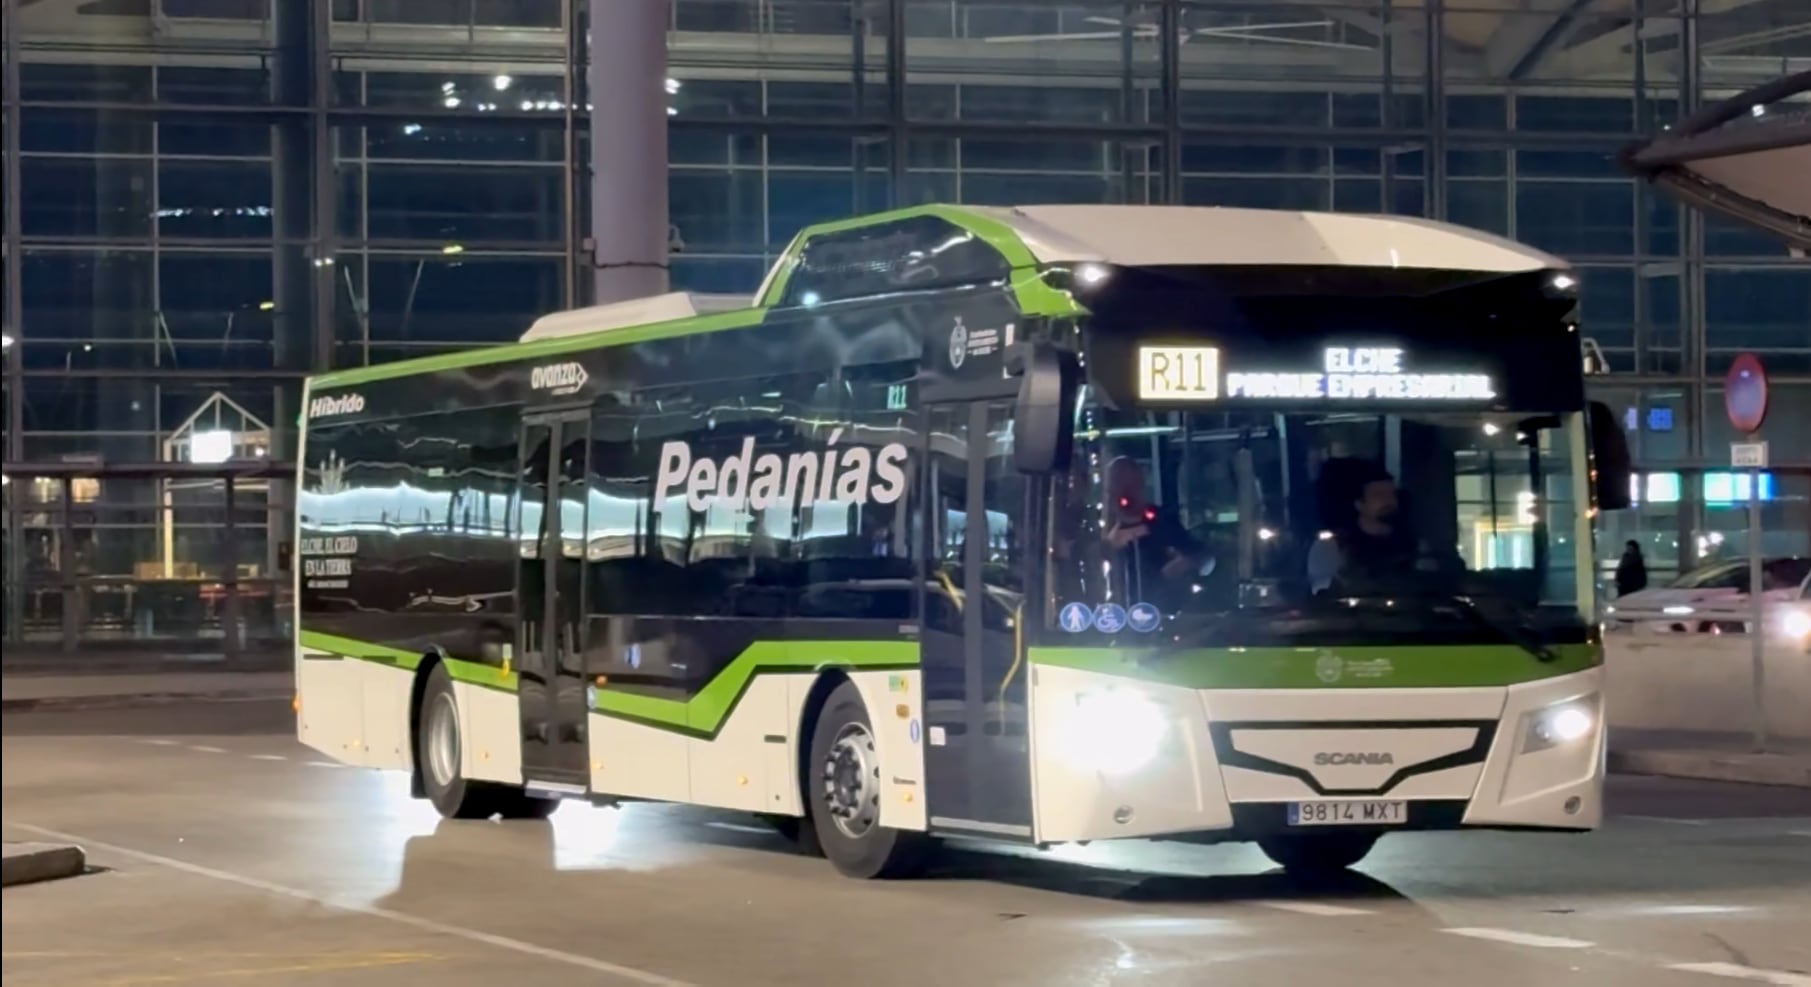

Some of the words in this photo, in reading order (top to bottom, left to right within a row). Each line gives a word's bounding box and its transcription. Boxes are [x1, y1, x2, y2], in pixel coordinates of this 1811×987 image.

[1149, 350, 1207, 393] R11
[1325, 347, 1404, 373] ELCHE
[531, 362, 577, 389] avanza
[887, 385, 907, 409] R11
[654, 427, 908, 513] Pedanías
[1314, 752, 1394, 766] SCANIA
[1302, 803, 1354, 821] 9814
[1363, 802, 1402, 820] MXT
